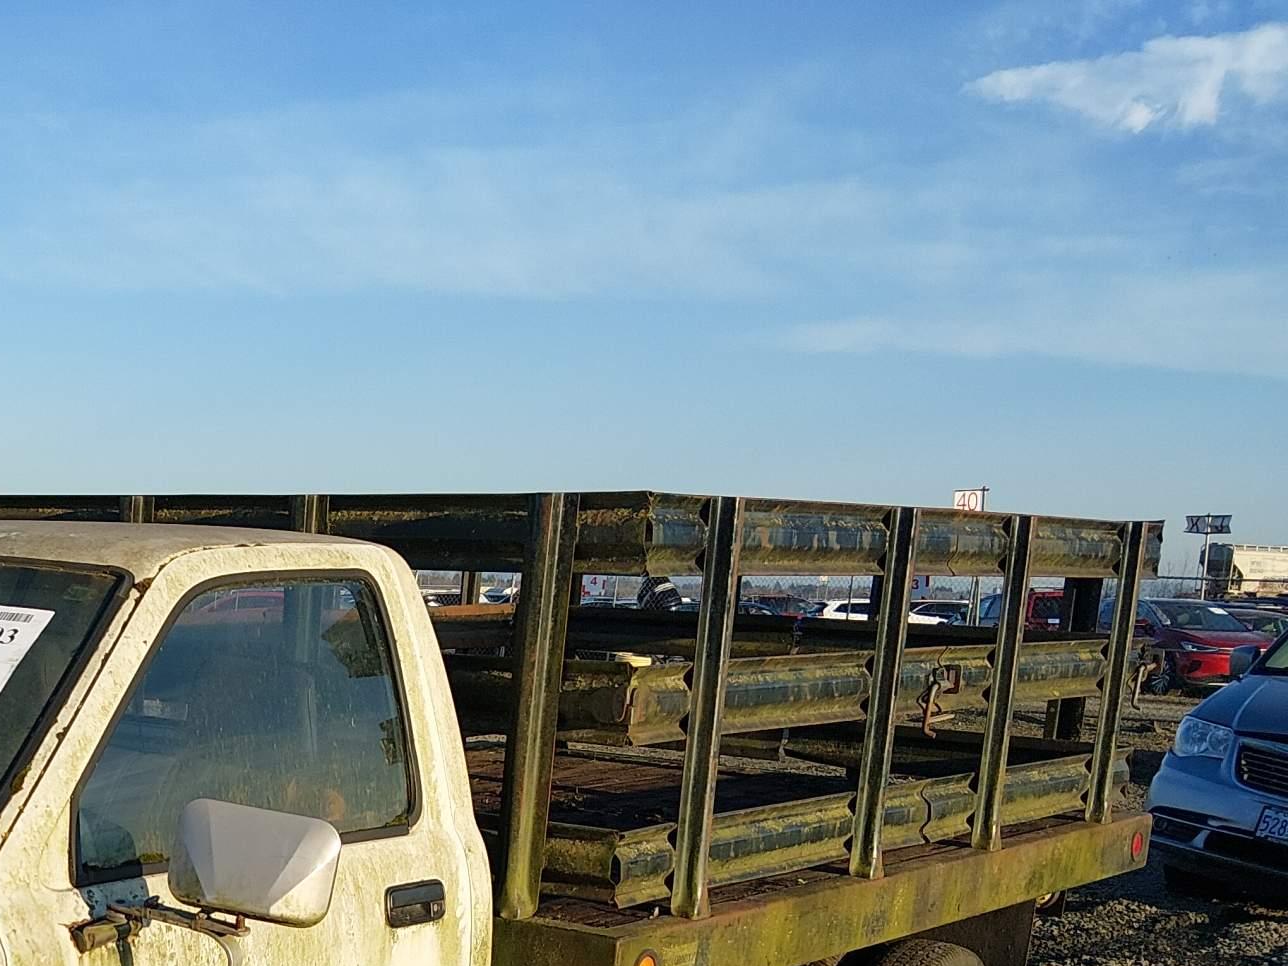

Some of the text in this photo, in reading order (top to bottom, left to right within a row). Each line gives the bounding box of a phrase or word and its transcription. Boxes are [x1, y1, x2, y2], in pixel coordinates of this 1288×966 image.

[956, 491, 978, 512] 40
[1189, 517, 1200, 532] X
[1259, 814, 1288, 837] 528
